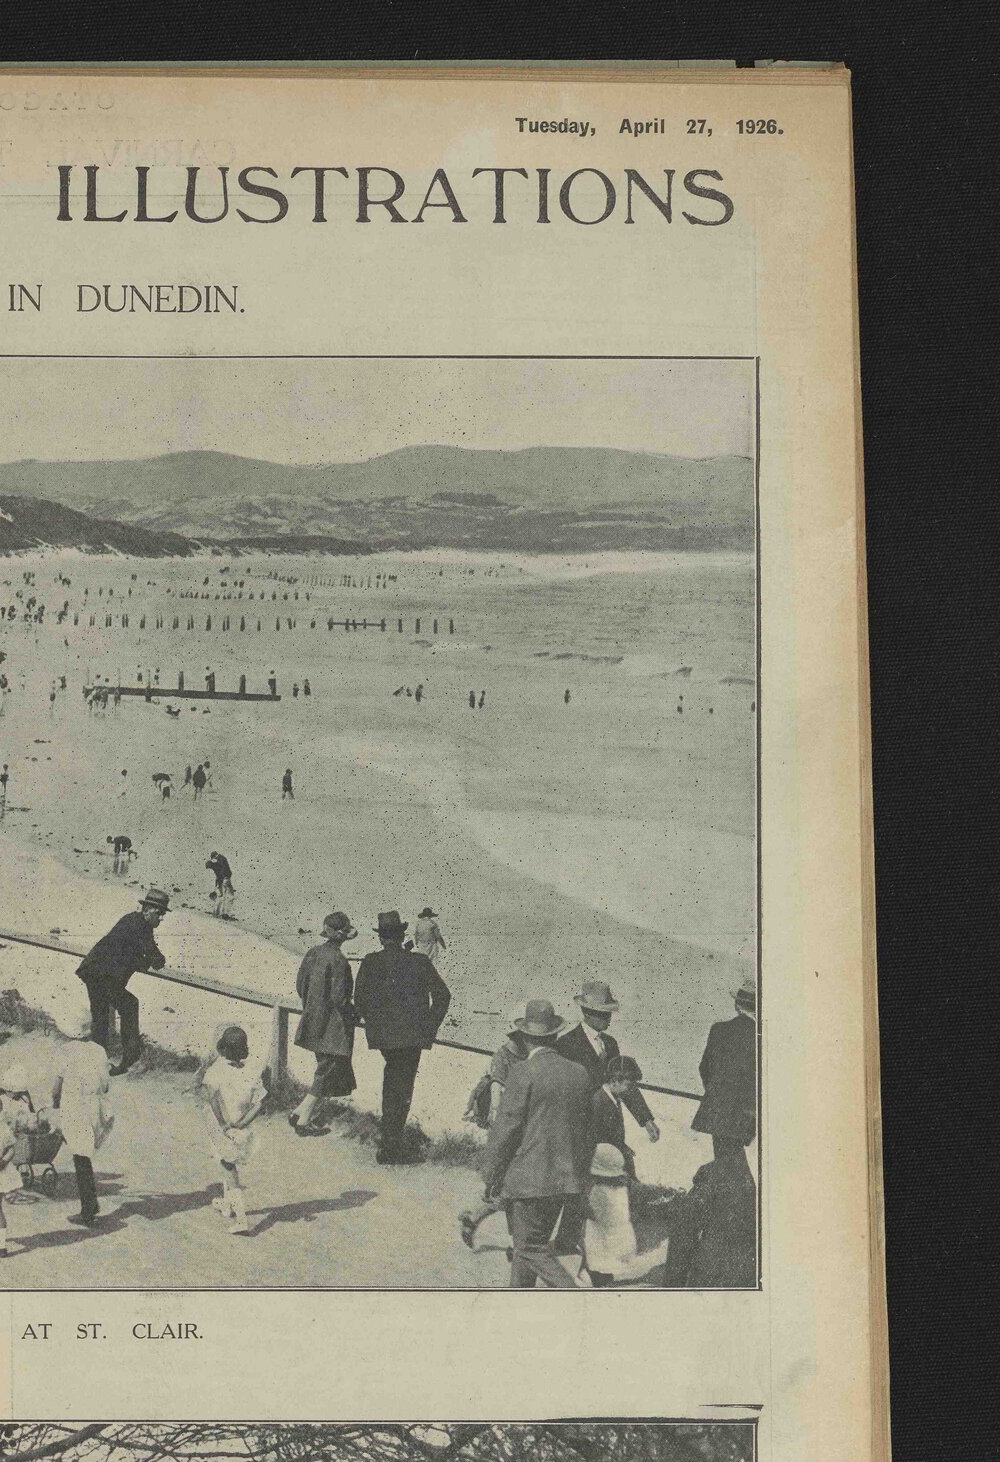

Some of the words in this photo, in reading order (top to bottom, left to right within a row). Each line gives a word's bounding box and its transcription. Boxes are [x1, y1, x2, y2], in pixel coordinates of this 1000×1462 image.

[515, 117, 596, 137] Tuesday,
[619, 117, 665, 138] April
[686, 119, 713, 137] 27,
[735, 119, 785, 135] 1926.
[56, 164, 735, 226] ILLUSTRATIONS
[8, 284, 43, 312] IN
[76, 284, 246, 314] DUNEDIN.
[21, 1323, 53, 1340] AT
[76, 1323, 107, 1340] ST.
[132, 1323, 204, 1340] CLAIR.
